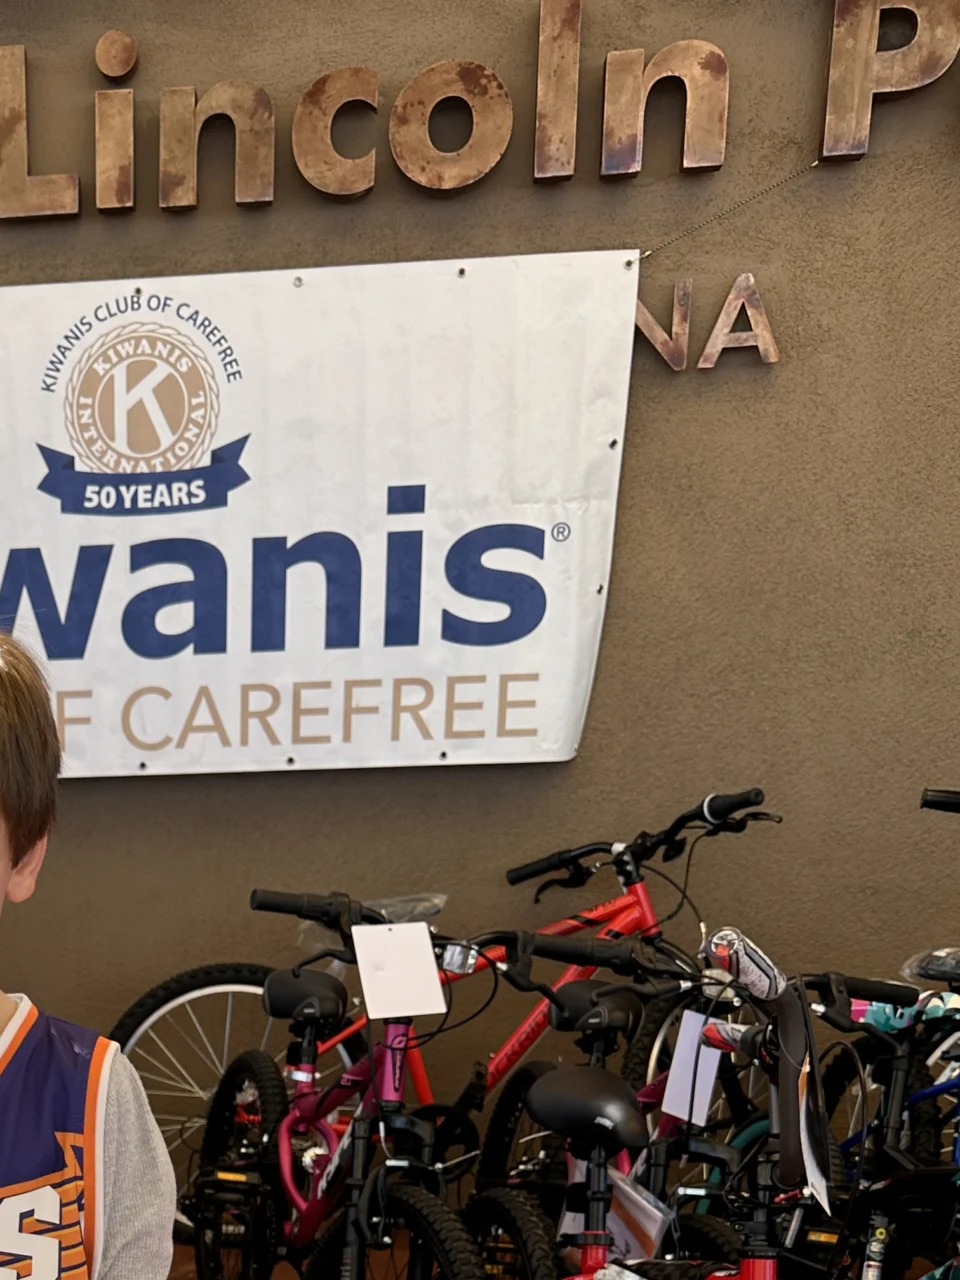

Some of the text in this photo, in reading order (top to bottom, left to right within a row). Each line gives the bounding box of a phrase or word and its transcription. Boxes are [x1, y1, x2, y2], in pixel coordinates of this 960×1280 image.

[41, 294, 243, 393] KIWANIS CLUB OF CAREFREE
[92, 339, 194, 378] KIWANIS
[77, 390, 206, 474] INTERNATIONAL
[83, 480, 207, 509] 50 YEARS
[56, 672, 541, 753] F CAREFREE
